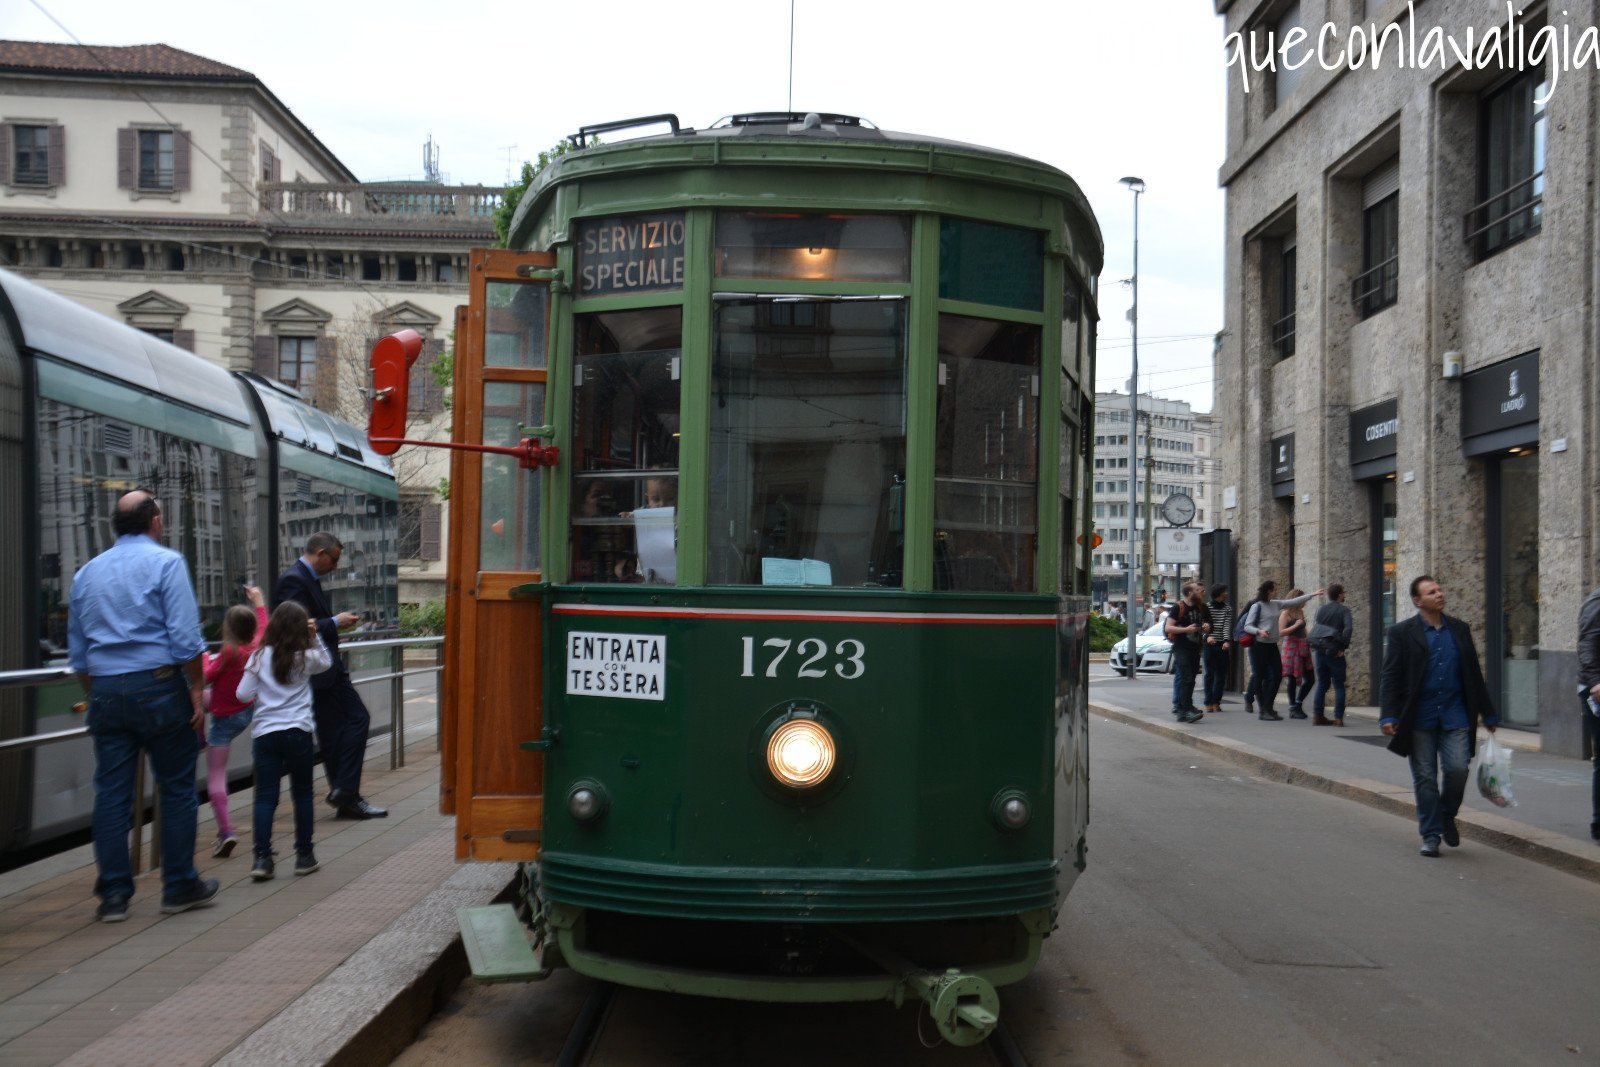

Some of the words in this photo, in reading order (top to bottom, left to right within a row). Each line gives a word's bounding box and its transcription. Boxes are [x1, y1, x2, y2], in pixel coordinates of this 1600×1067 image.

[584, 220, 685, 254] SERVIZIO
[582, 256, 684, 290] SPECIALE
[572, 636, 660, 663] ENTRATA
[740, 636, 865, 679] 1723
[604, 662, 627, 671] CON
[571, 669, 659, 695] TESSERA
